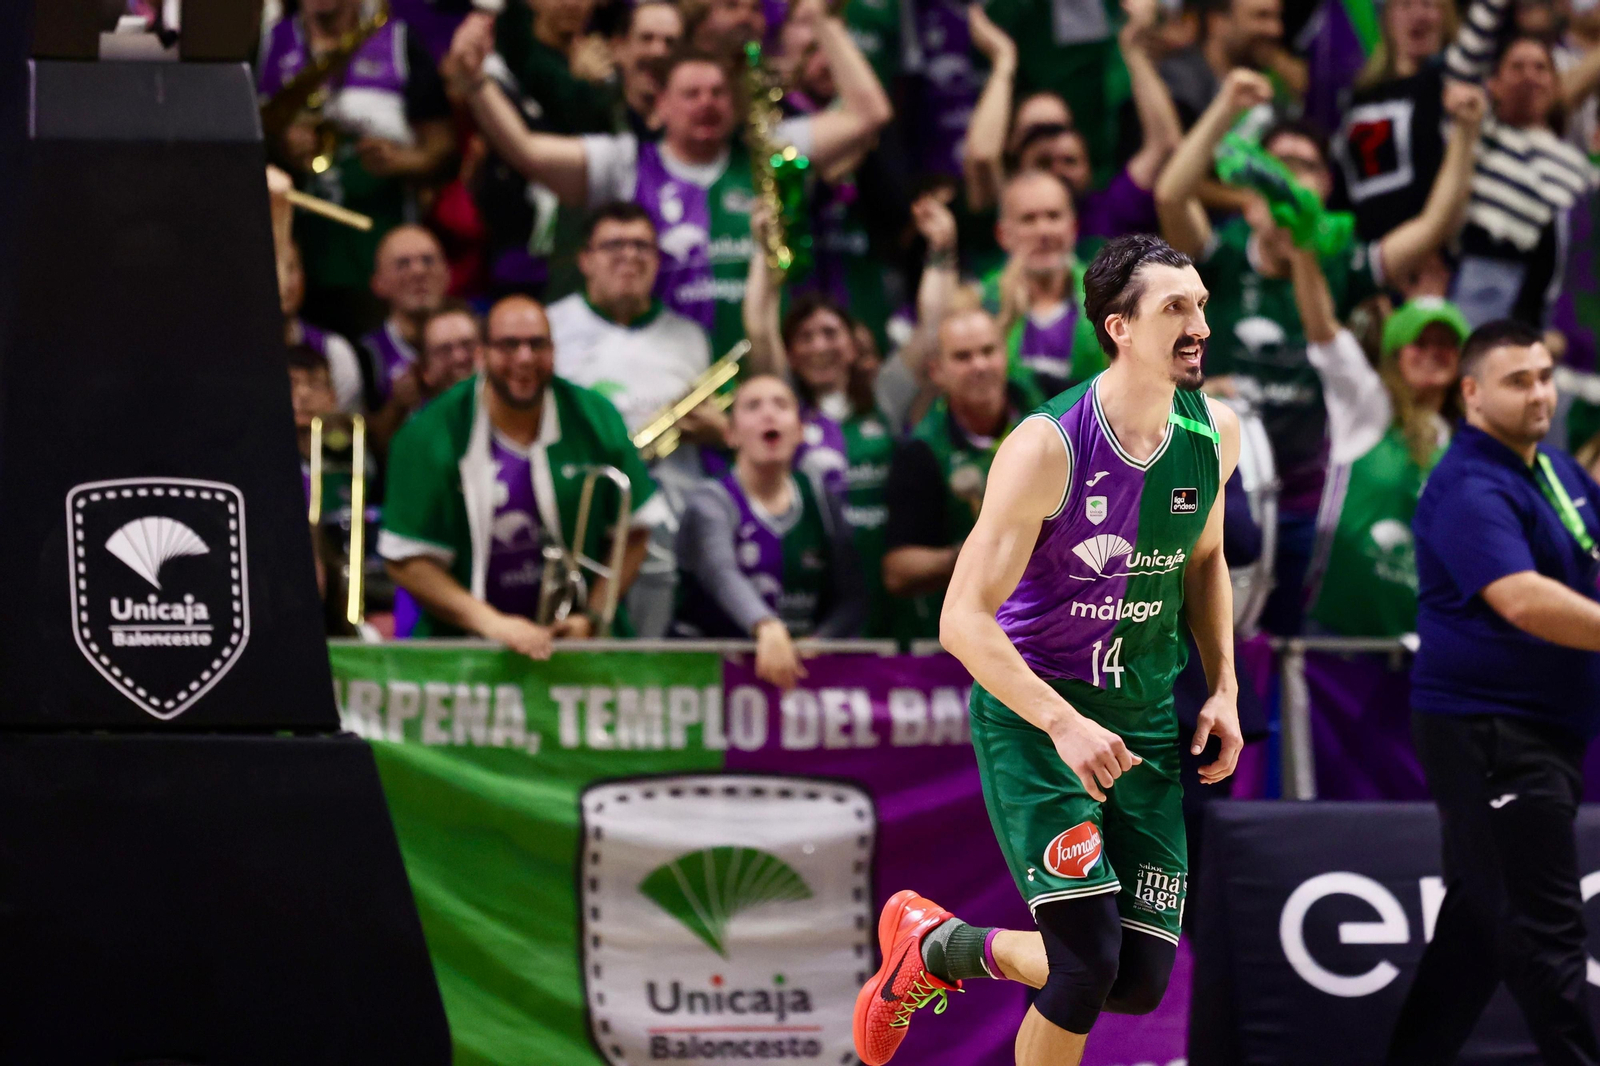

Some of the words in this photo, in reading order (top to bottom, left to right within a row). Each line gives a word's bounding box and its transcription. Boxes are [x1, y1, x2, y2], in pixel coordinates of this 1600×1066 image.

[1173, 503, 1196, 511] endesa
[1126, 549, 1186, 569] Unicaja
[110, 593, 209, 625] Unicaja
[1070, 596, 1162, 623] málaga
[111, 631, 212, 647] Baloncesto
[1092, 637, 1125, 688] 14
[549, 683, 769, 751] TEMPLO
[780, 686, 880, 750] DEL
[887, 686, 974, 748] BA
[1139, 862, 1163, 872] sabor
[646, 973, 813, 1023] Unicaja
[651, 1035, 823, 1060] Baloncesto
